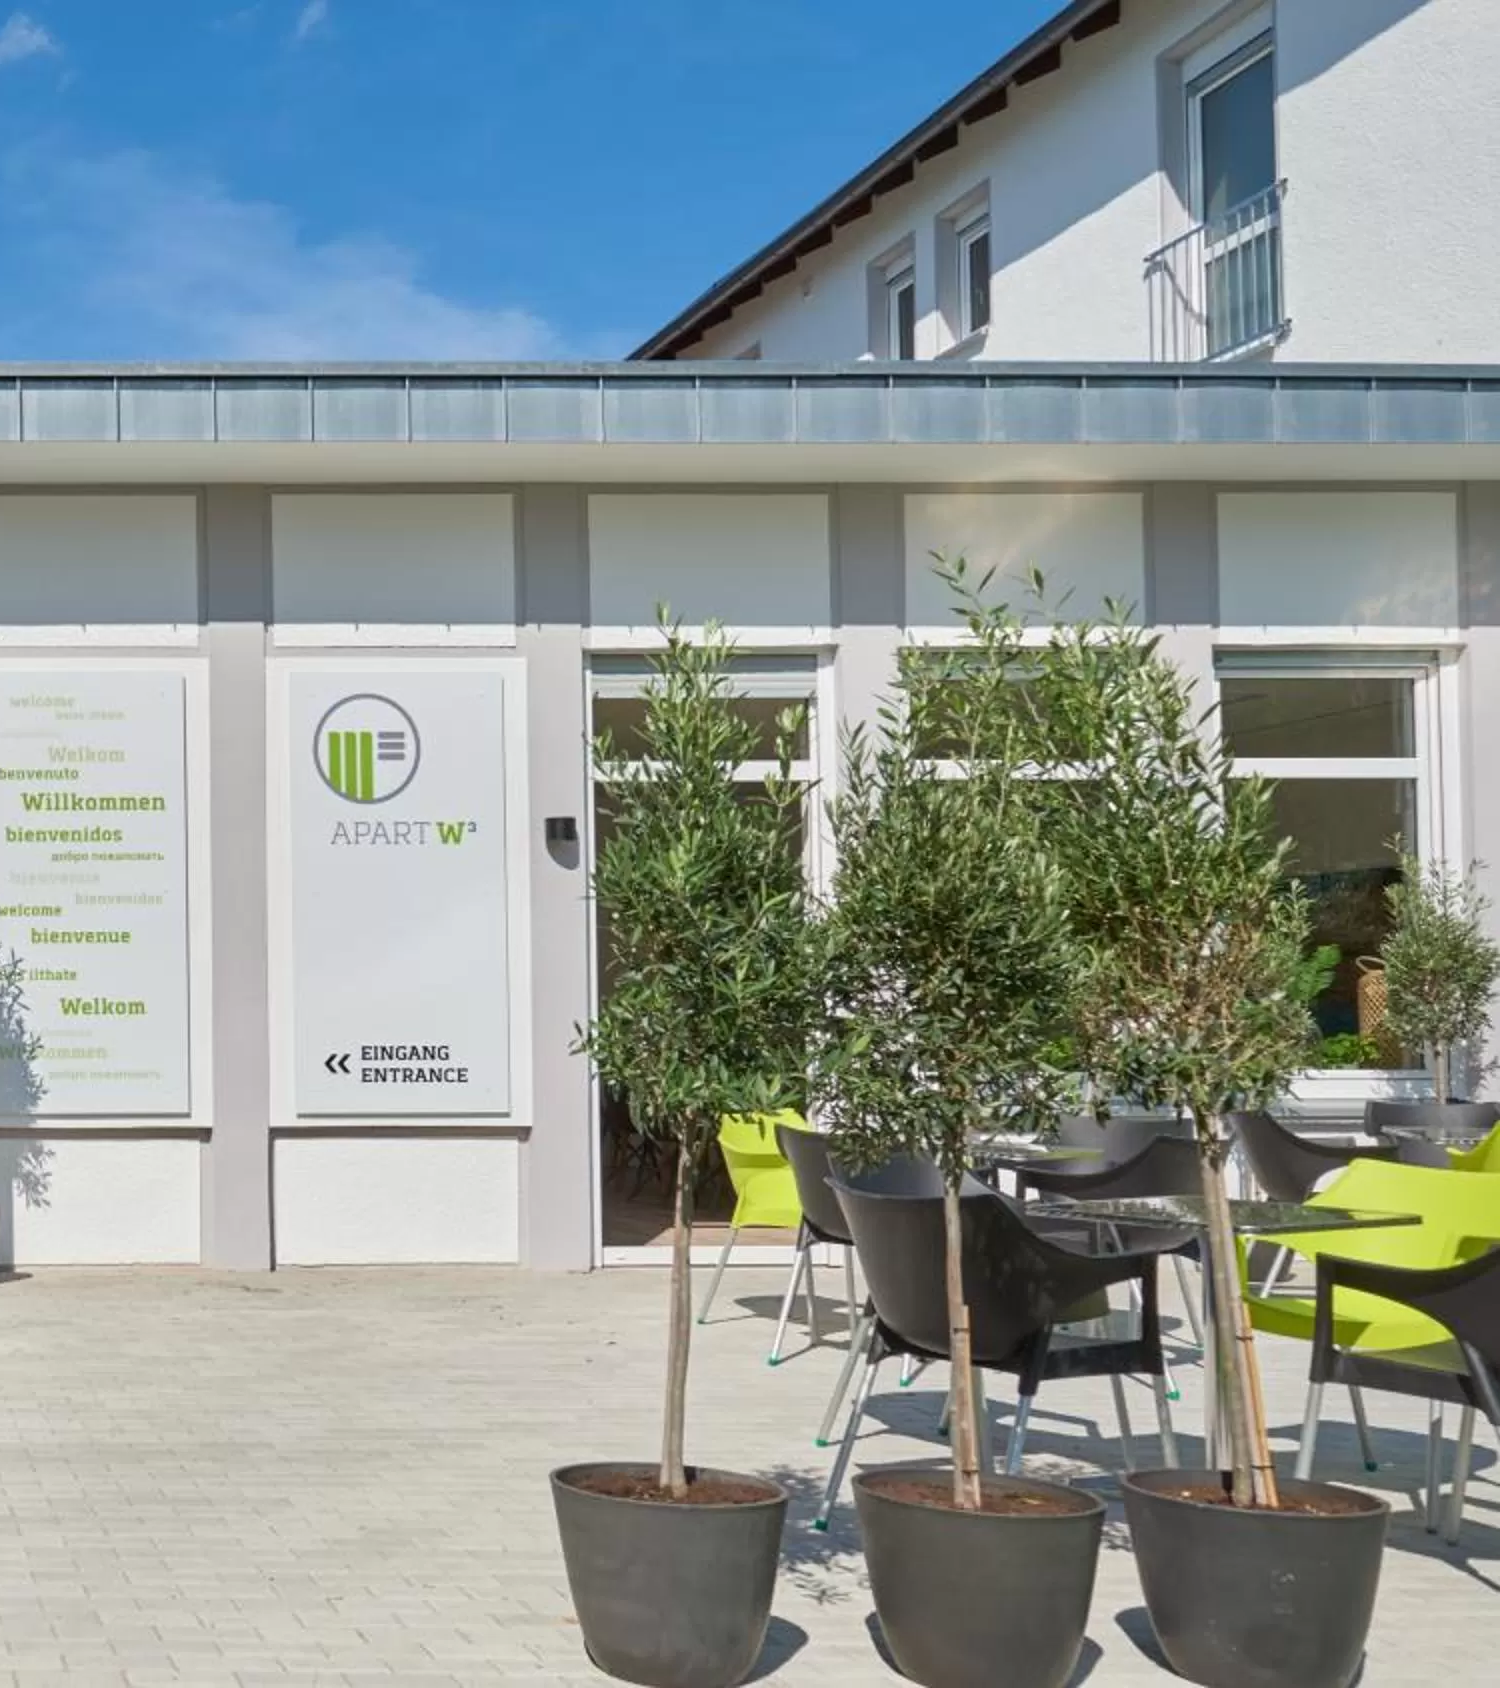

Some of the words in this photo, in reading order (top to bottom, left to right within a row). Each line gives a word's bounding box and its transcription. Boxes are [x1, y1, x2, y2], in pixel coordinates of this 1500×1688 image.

[21, 793, 165, 811] Willkommen
[6, 826, 122, 842] bienvenidos
[331, 821, 431, 845] APART
[31, 928, 131, 944] bienvenue
[60, 997, 145, 1015] Welkom
[361, 1046, 449, 1061] EINGANG
[361, 1067, 468, 1083] ENTRANCE
